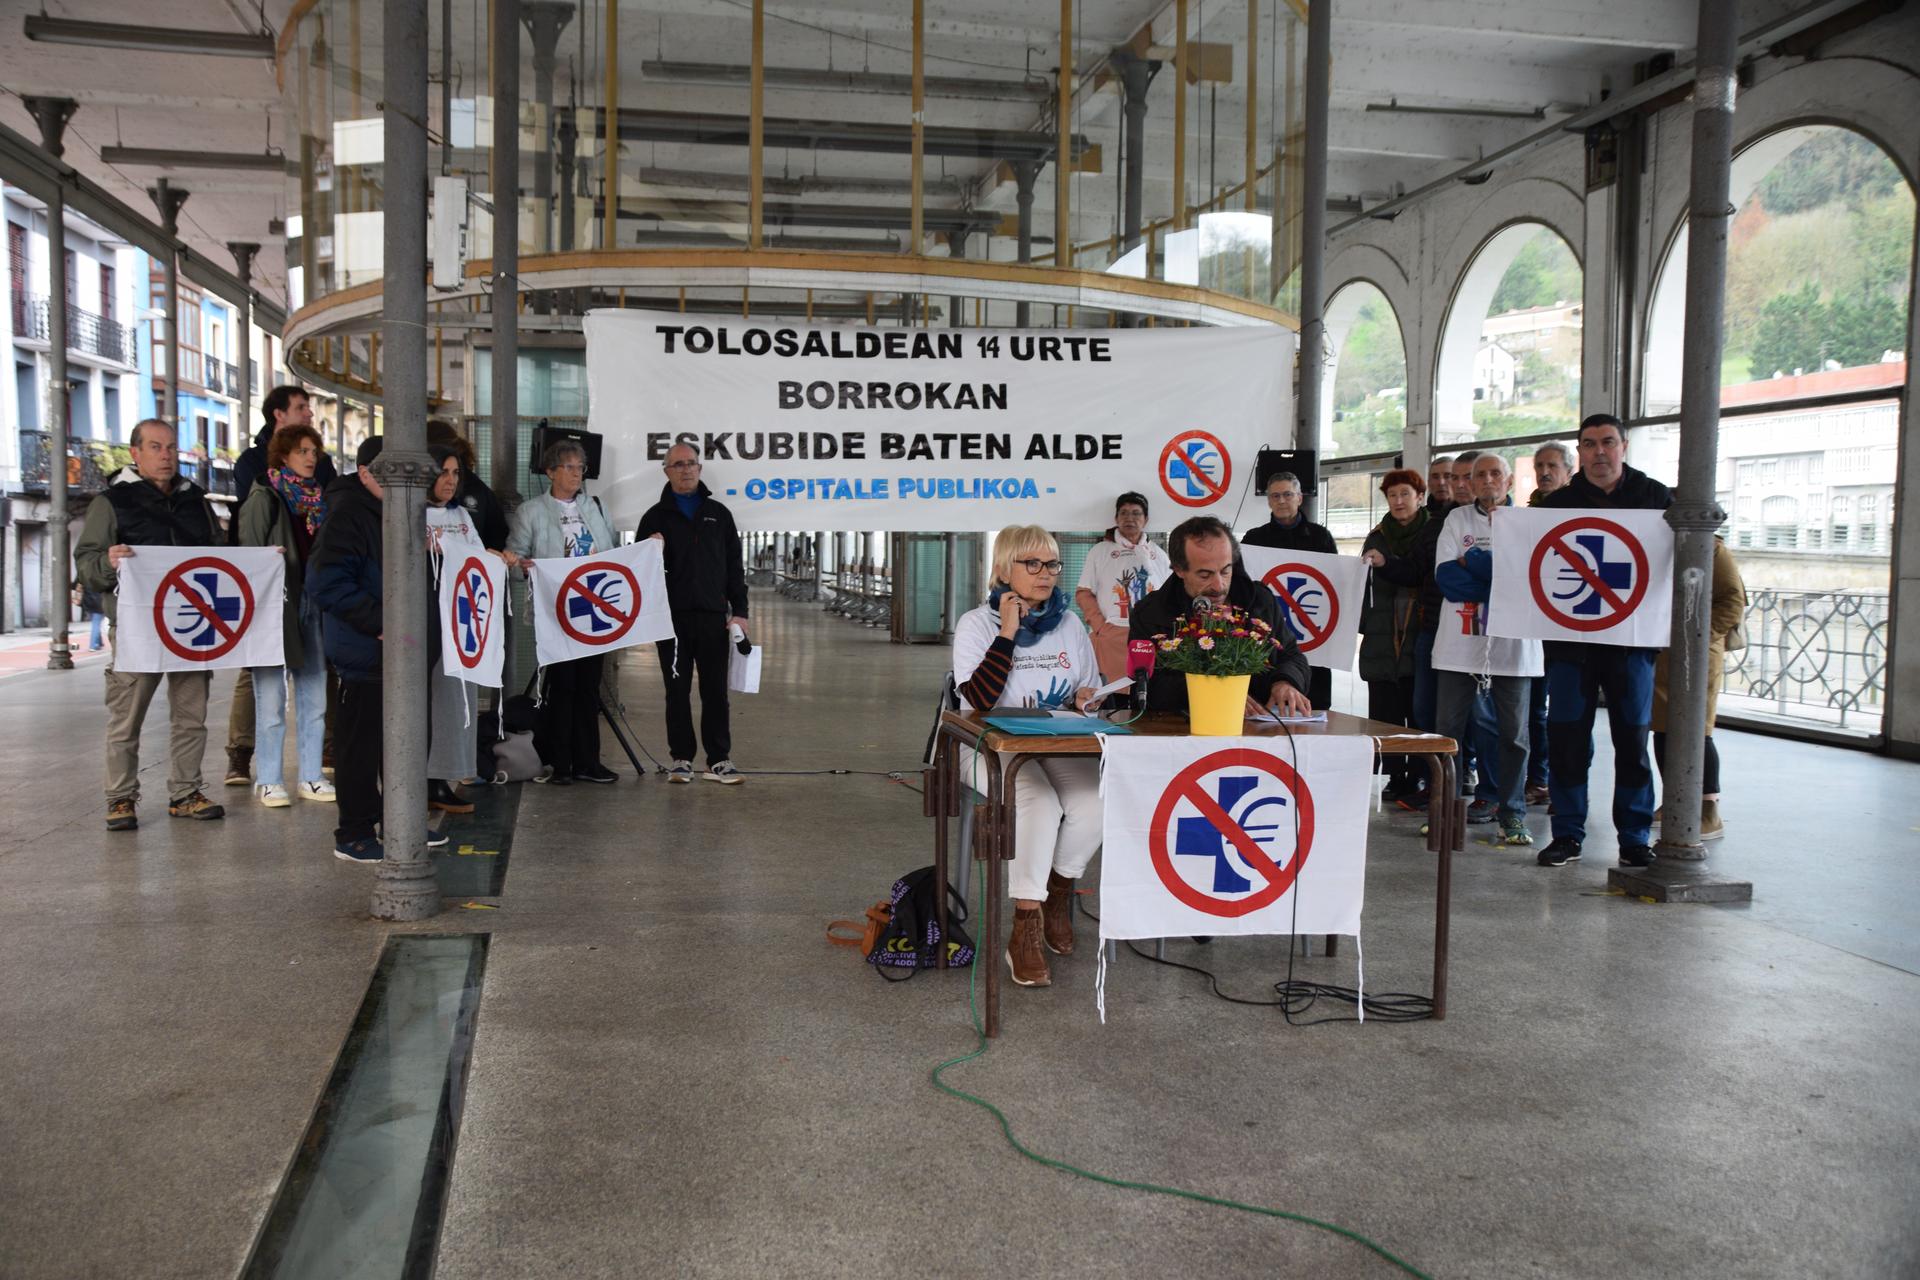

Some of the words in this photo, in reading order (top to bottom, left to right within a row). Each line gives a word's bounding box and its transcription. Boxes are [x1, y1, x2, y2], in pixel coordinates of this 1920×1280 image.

[656, 325, 963, 360] TOLOSALDEAN
[976, 335, 1001, 359] 14
[1009, 335, 1112, 362] URTE
[778, 380, 1008, 410] BORROKAN
[647, 432, 866, 461] ESKUBIDE
[880, 432, 1012, 461] BATEN
[1023, 433, 1123, 461] ALDE
[744, 478, 889, 501] OSPITALE
[897, 477, 1039, 500] PUBLIKOA
